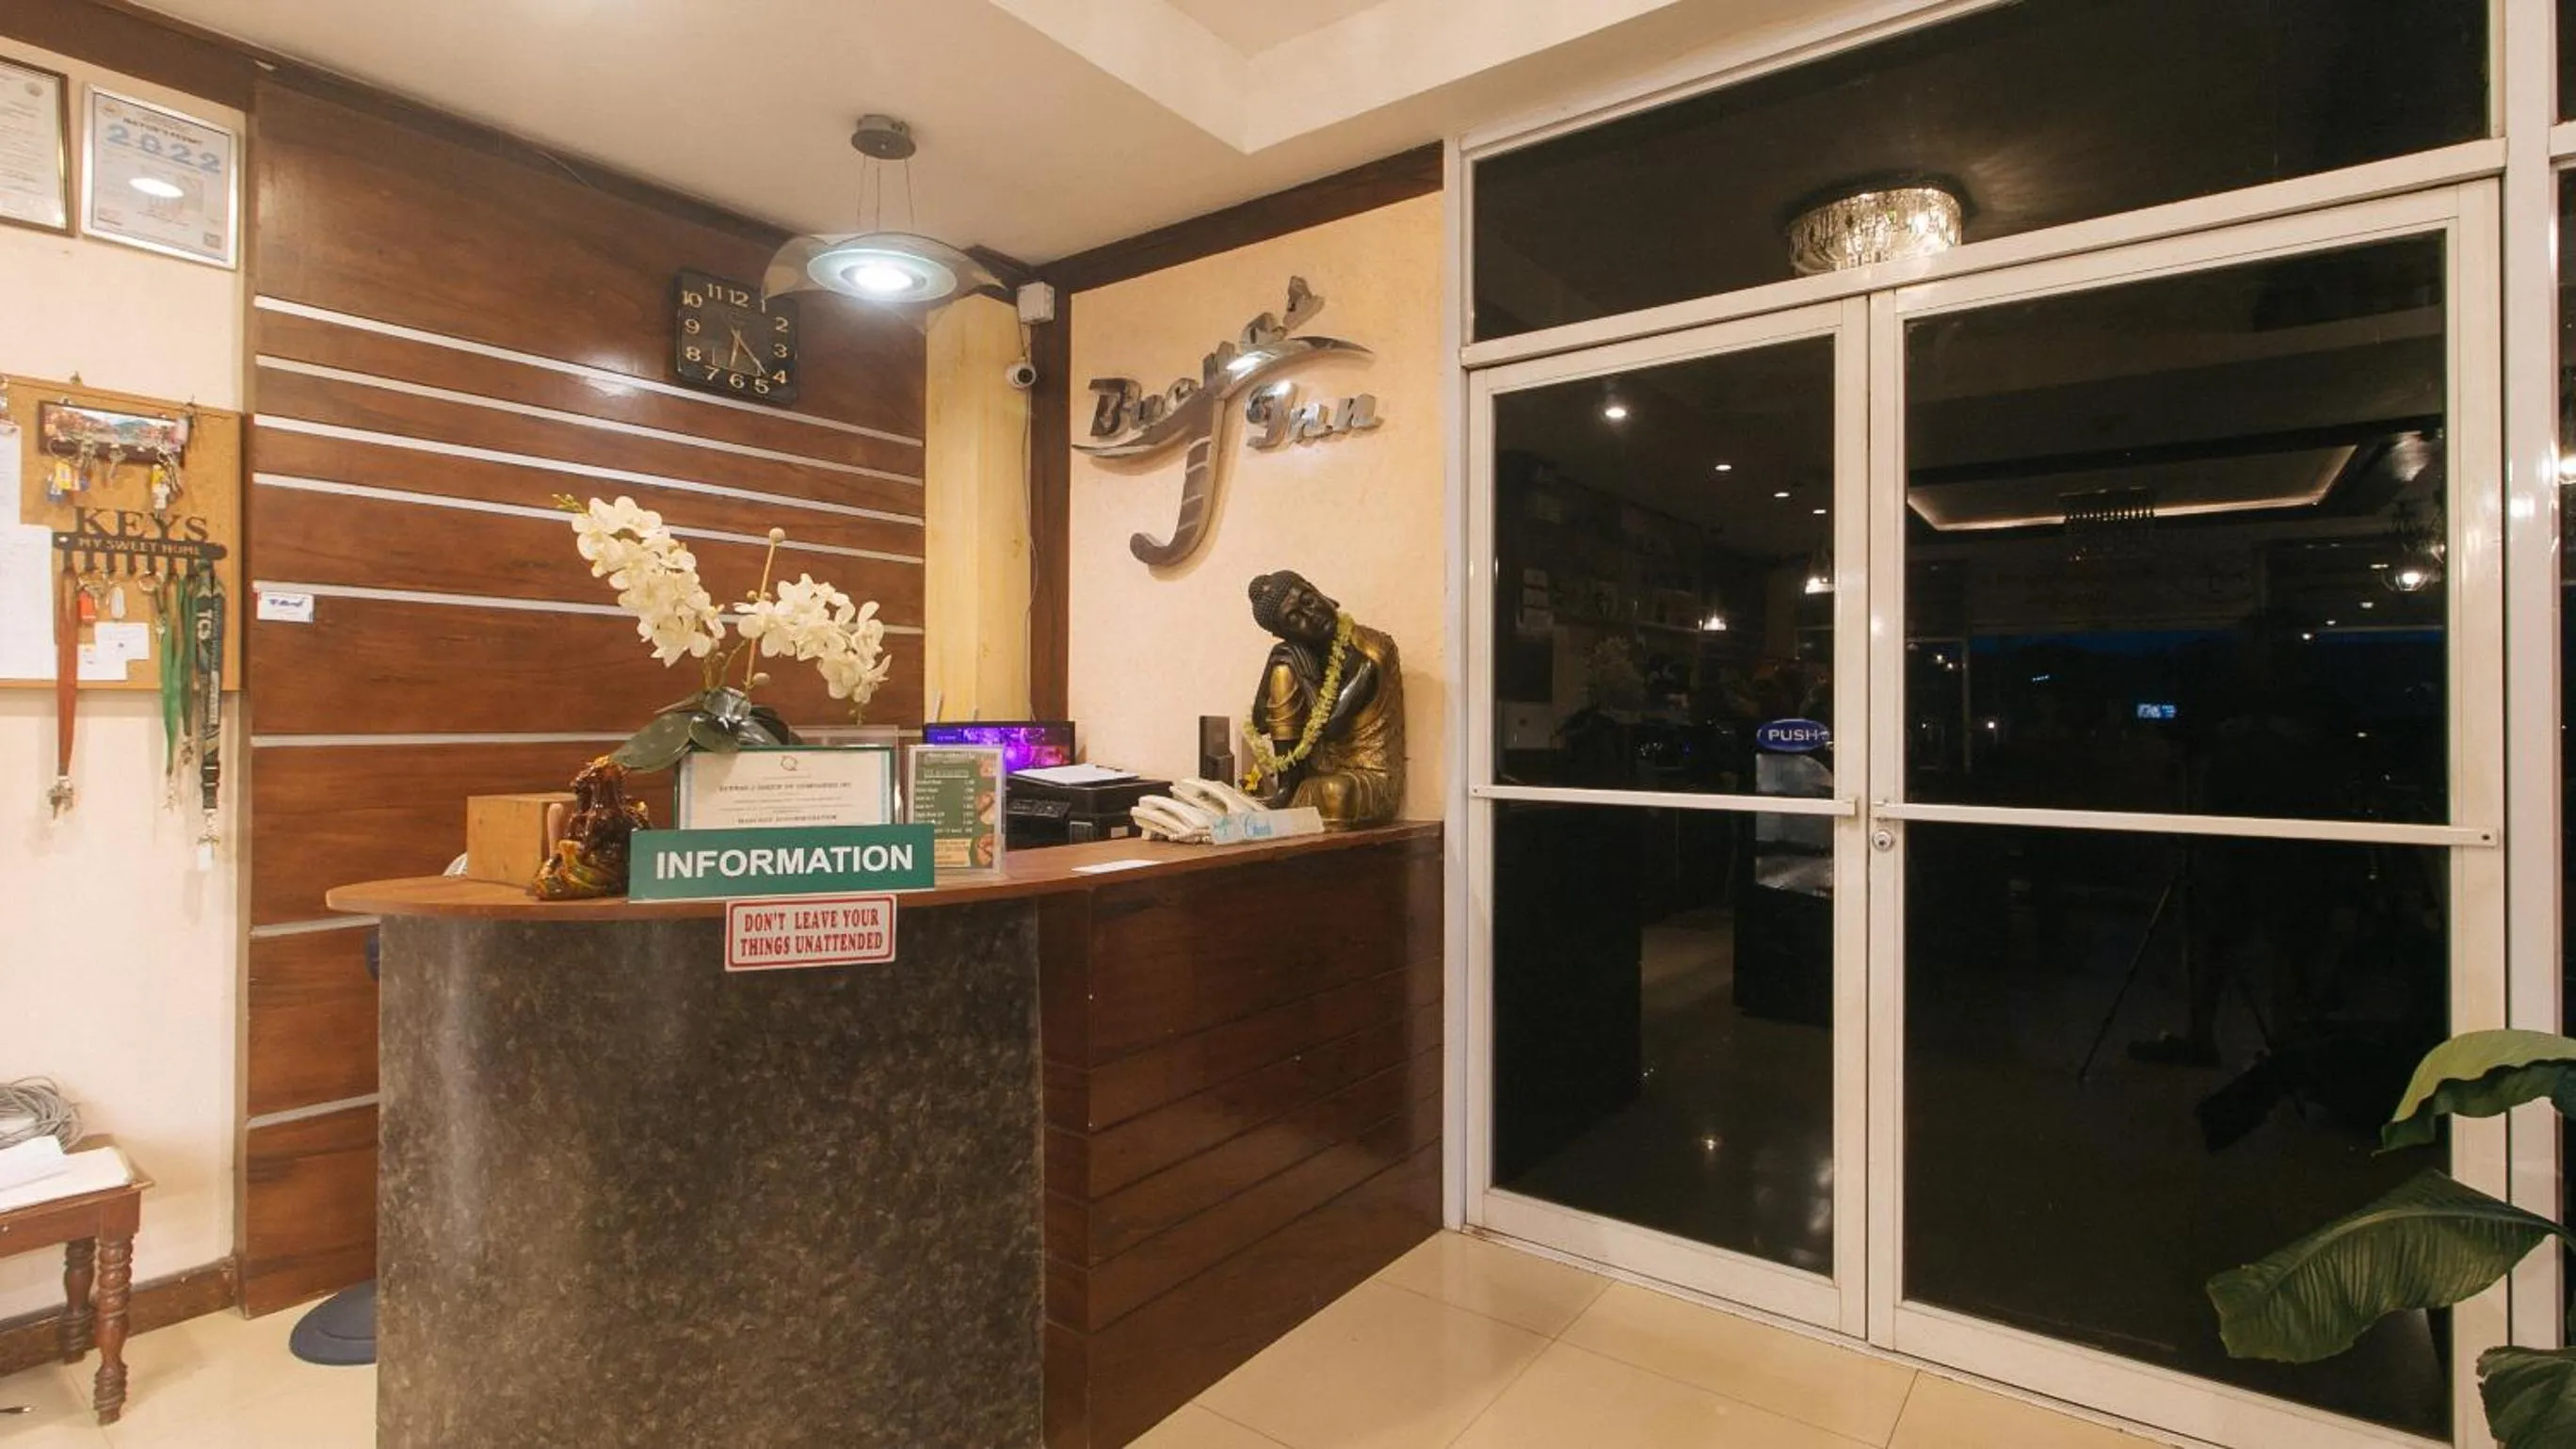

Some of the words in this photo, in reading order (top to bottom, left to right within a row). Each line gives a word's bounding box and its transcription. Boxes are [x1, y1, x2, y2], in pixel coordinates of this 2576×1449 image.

[106, 123, 222, 174] 2022
[682, 290, 703, 308] 10
[707, 283, 722, 300] 11
[728, 289, 749, 308] 12
[684, 318, 700, 334] 9
[775, 316, 789, 332] 2
[685, 346, 701, 362] 8
[773, 343, 788, 359] 3
[704, 364, 720, 381] 7
[772, 369, 786, 384] 4
[729, 373, 745, 389] 6
[754, 378, 770, 394] 5
[75, 506, 209, 543] KEYS
[78, 537, 103, 549] MY
[106, 539, 158, 553] SWEET
[1768, 729, 1818, 742] PUSH
[656, 844, 913, 880] INFORMATION
[744, 911, 786, 933] DON'T
[795, 910, 838, 930] LEAVE
[844, 908, 879, 927] YOUR
[740, 936, 791, 958] THINGS
[795, 931, 883, 954] UNATTENDED
